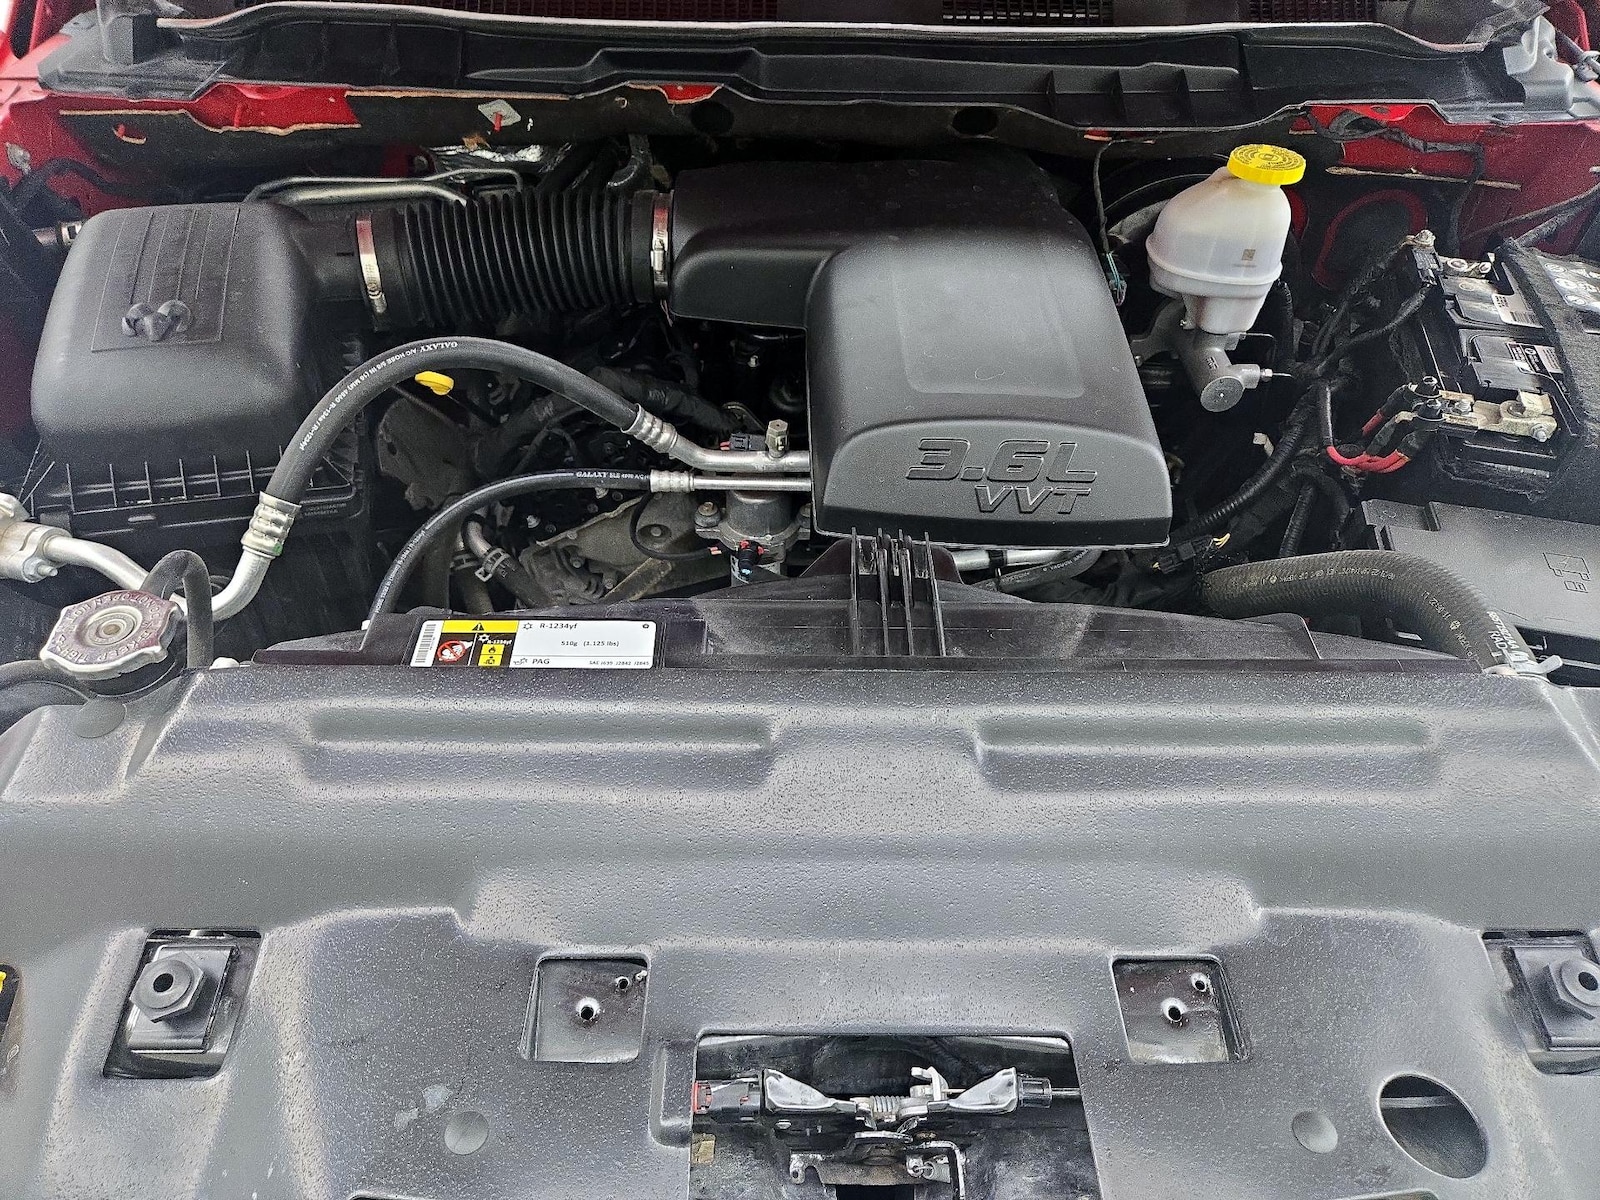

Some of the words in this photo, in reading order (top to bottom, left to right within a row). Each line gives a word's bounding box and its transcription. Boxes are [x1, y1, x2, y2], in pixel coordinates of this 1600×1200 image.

[405, 347, 417, 356] A/C
[419, 341, 458, 353] GALAXY
[386, 352, 405, 363] HOSE
[905, 437, 1098, 483] 3.6L
[974, 485, 1091, 514] VVT
[539, 622, 578, 630] R-1234yf
[1488, 629, 1508, 652] RAD
[97, 640, 140, 662] KEEP
